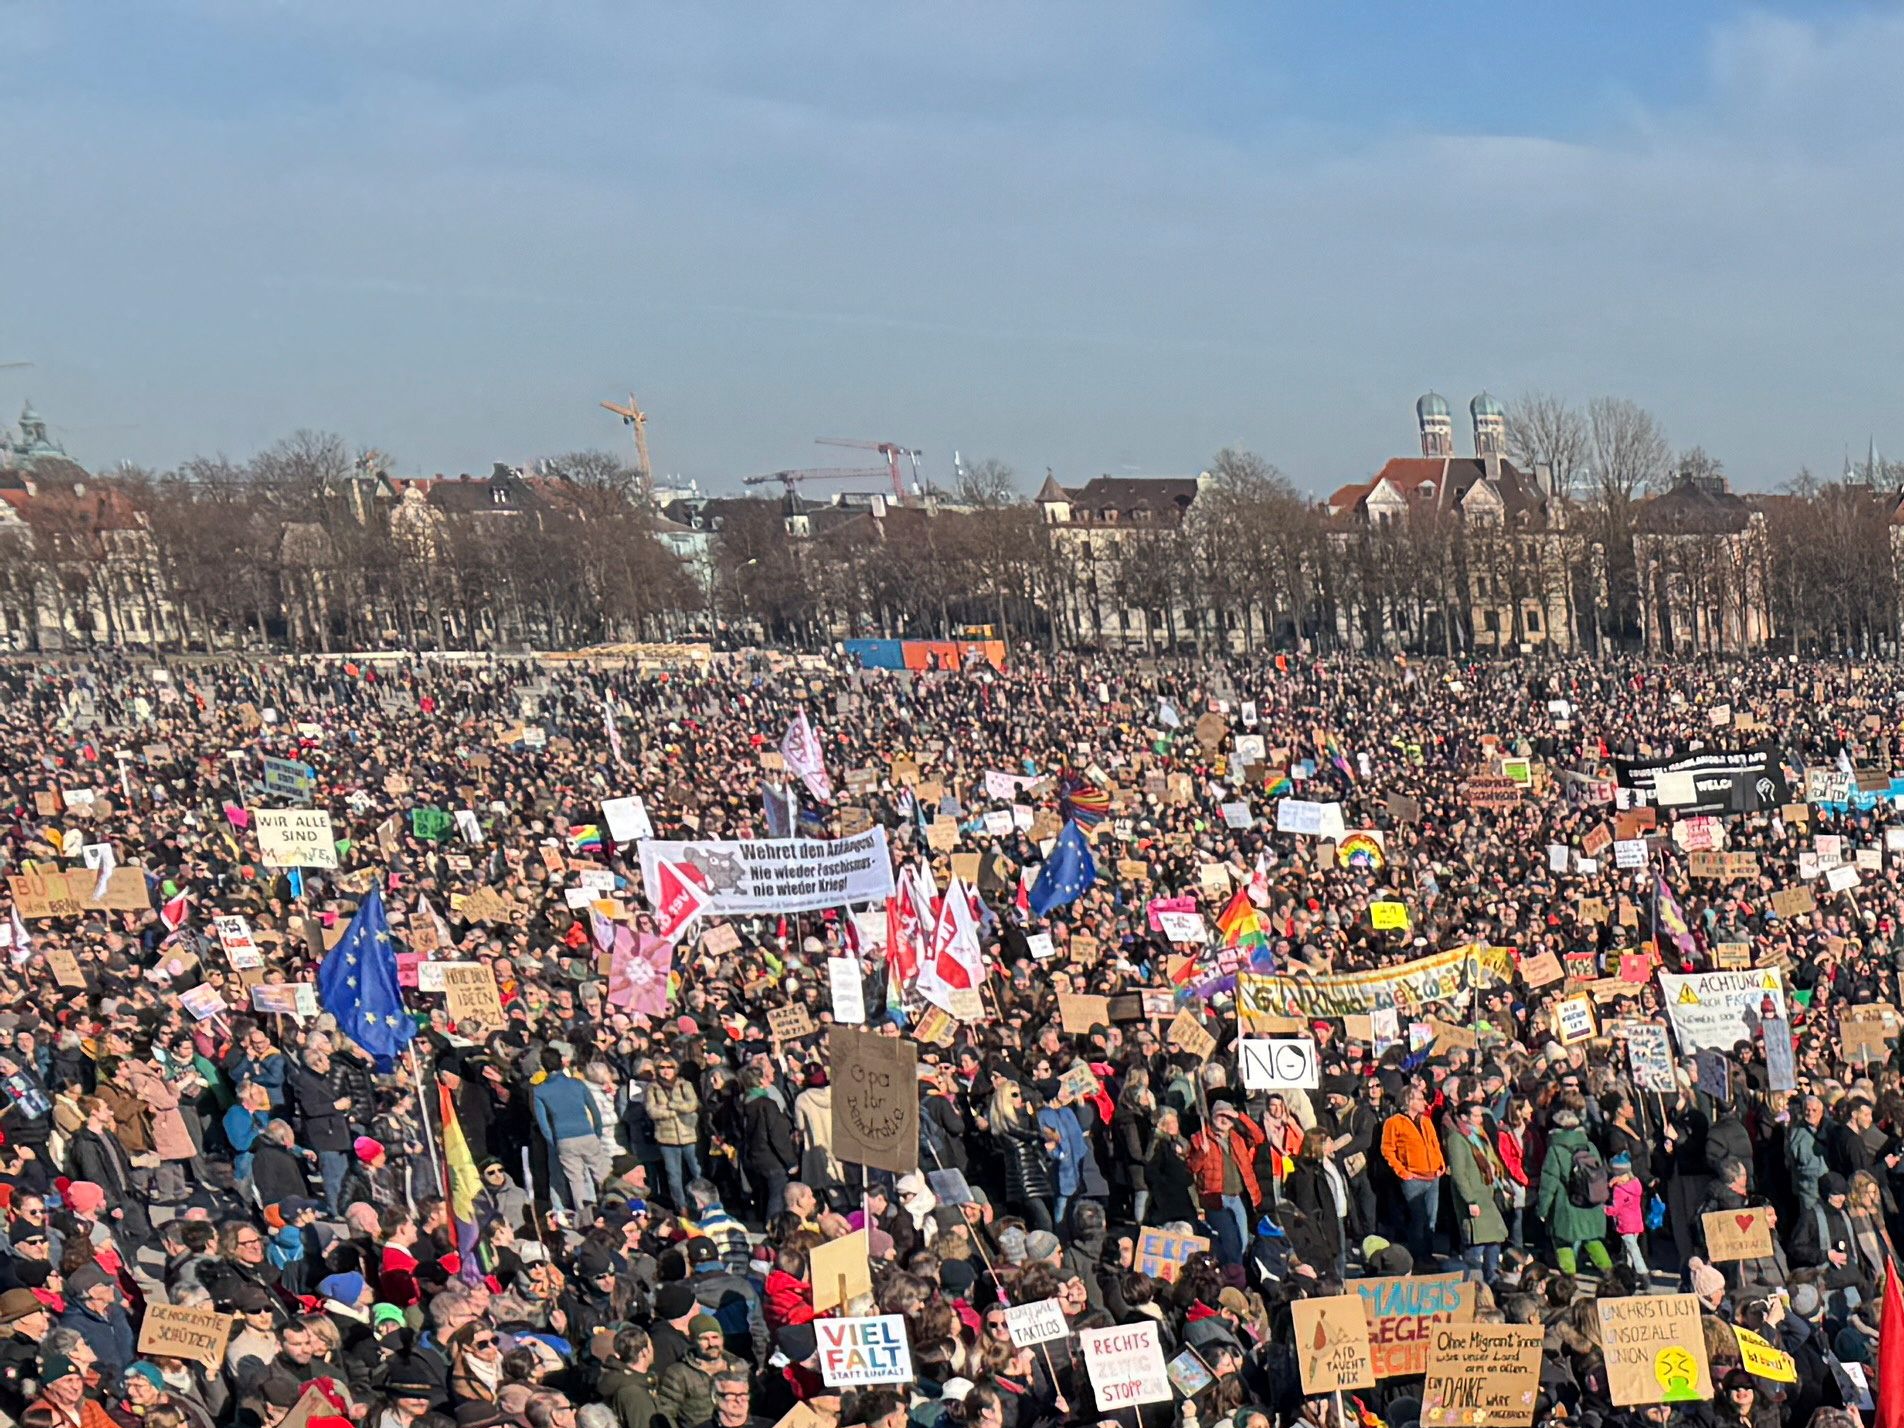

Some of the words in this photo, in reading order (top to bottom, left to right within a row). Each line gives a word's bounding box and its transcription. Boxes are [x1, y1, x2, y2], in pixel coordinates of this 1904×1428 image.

[258, 816, 288, 828] WIR
[296, 815, 328, 828] ALLE
[282, 830, 318, 843] SIND
[740, 841, 798, 861] Wehret
[800, 840, 825, 859] den
[750, 865, 771, 880] Nie
[773, 863, 815, 881] wieder
[753, 881, 775, 897] nie
[777, 879, 817, 896] wieder
[1698, 974, 1760, 993] ACHTUNG
[822, 1321, 901, 1348] VIEL
[1437, 1331, 1468, 1351] Ohne
[1605, 1322, 1680, 1345] UNSOZIALE
[1093, 1330, 1152, 1357] RECHTS
[825, 1345, 902, 1372] FALT
[1608, 1347, 1649, 1365] UNION
[830, 1369, 863, 1381] STATT
[863, 1367, 905, 1380] EINFALT
[1441, 1377, 1489, 1409] DANKE
